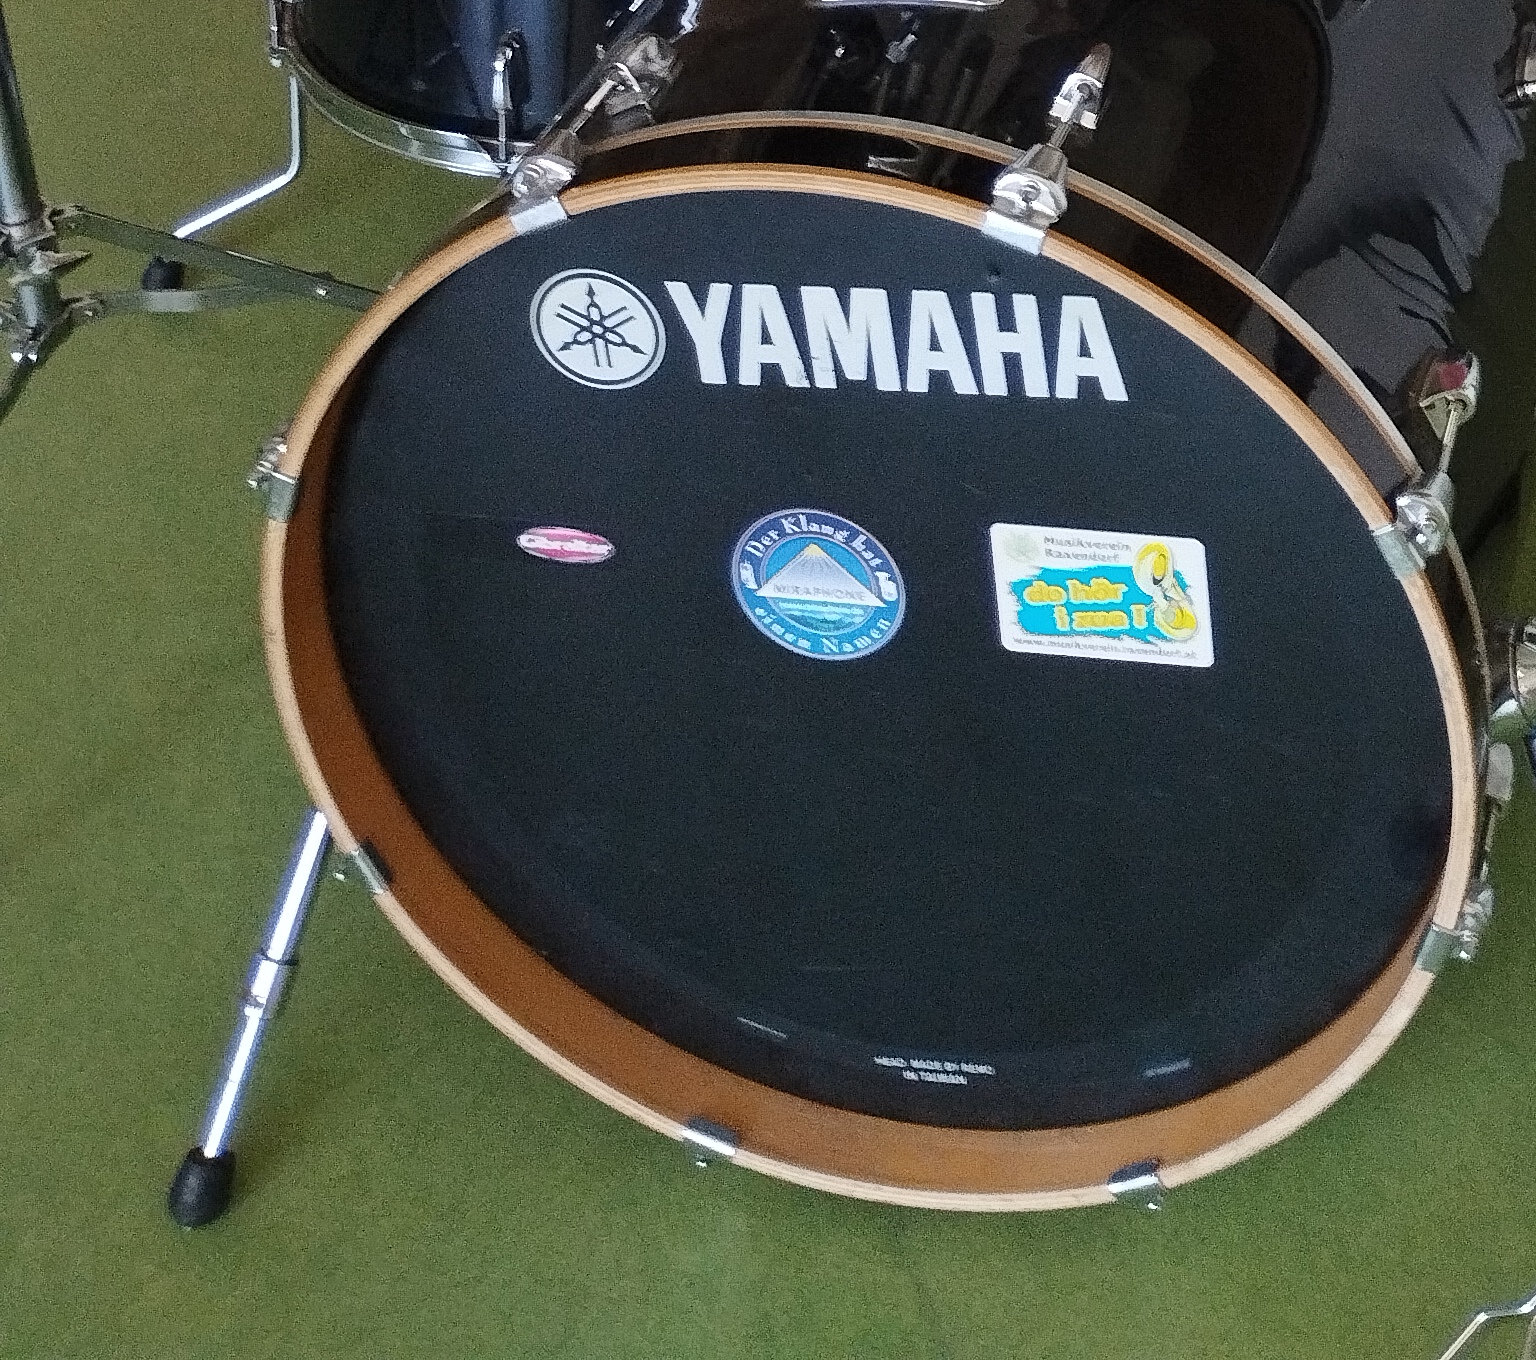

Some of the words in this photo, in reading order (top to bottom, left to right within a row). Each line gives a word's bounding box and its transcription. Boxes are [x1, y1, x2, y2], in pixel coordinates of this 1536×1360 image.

[663, 279, 1129, 402] YAMAHA
[744, 528, 781, 558] Der
[780, 513, 851, 543] Klang
[850, 533, 884, 568] hat
[820, 618, 892, 653] Namen
